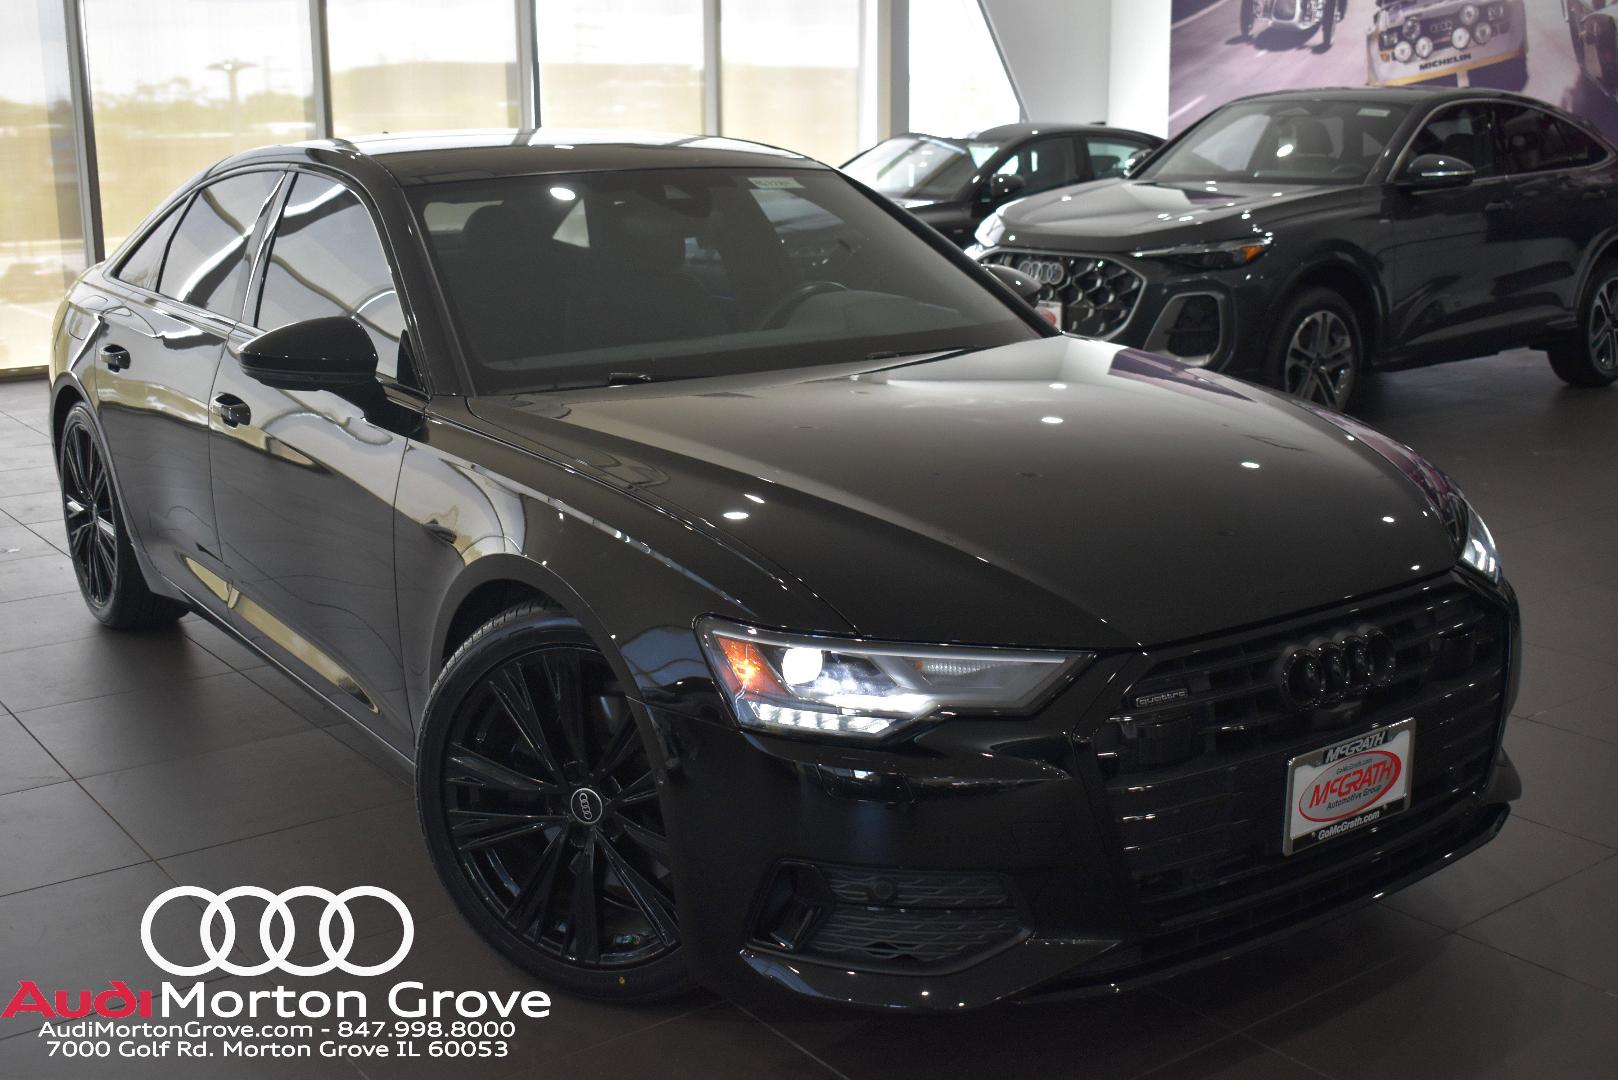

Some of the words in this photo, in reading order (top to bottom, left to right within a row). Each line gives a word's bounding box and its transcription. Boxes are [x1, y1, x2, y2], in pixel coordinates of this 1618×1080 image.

[1420, 54, 1471, 70] MICHELIN
[1138, 691, 1186, 706] quattro
[1326, 792, 1363, 811] Automotive
[1318, 811, 1380, 840] GoMcGrath.com
